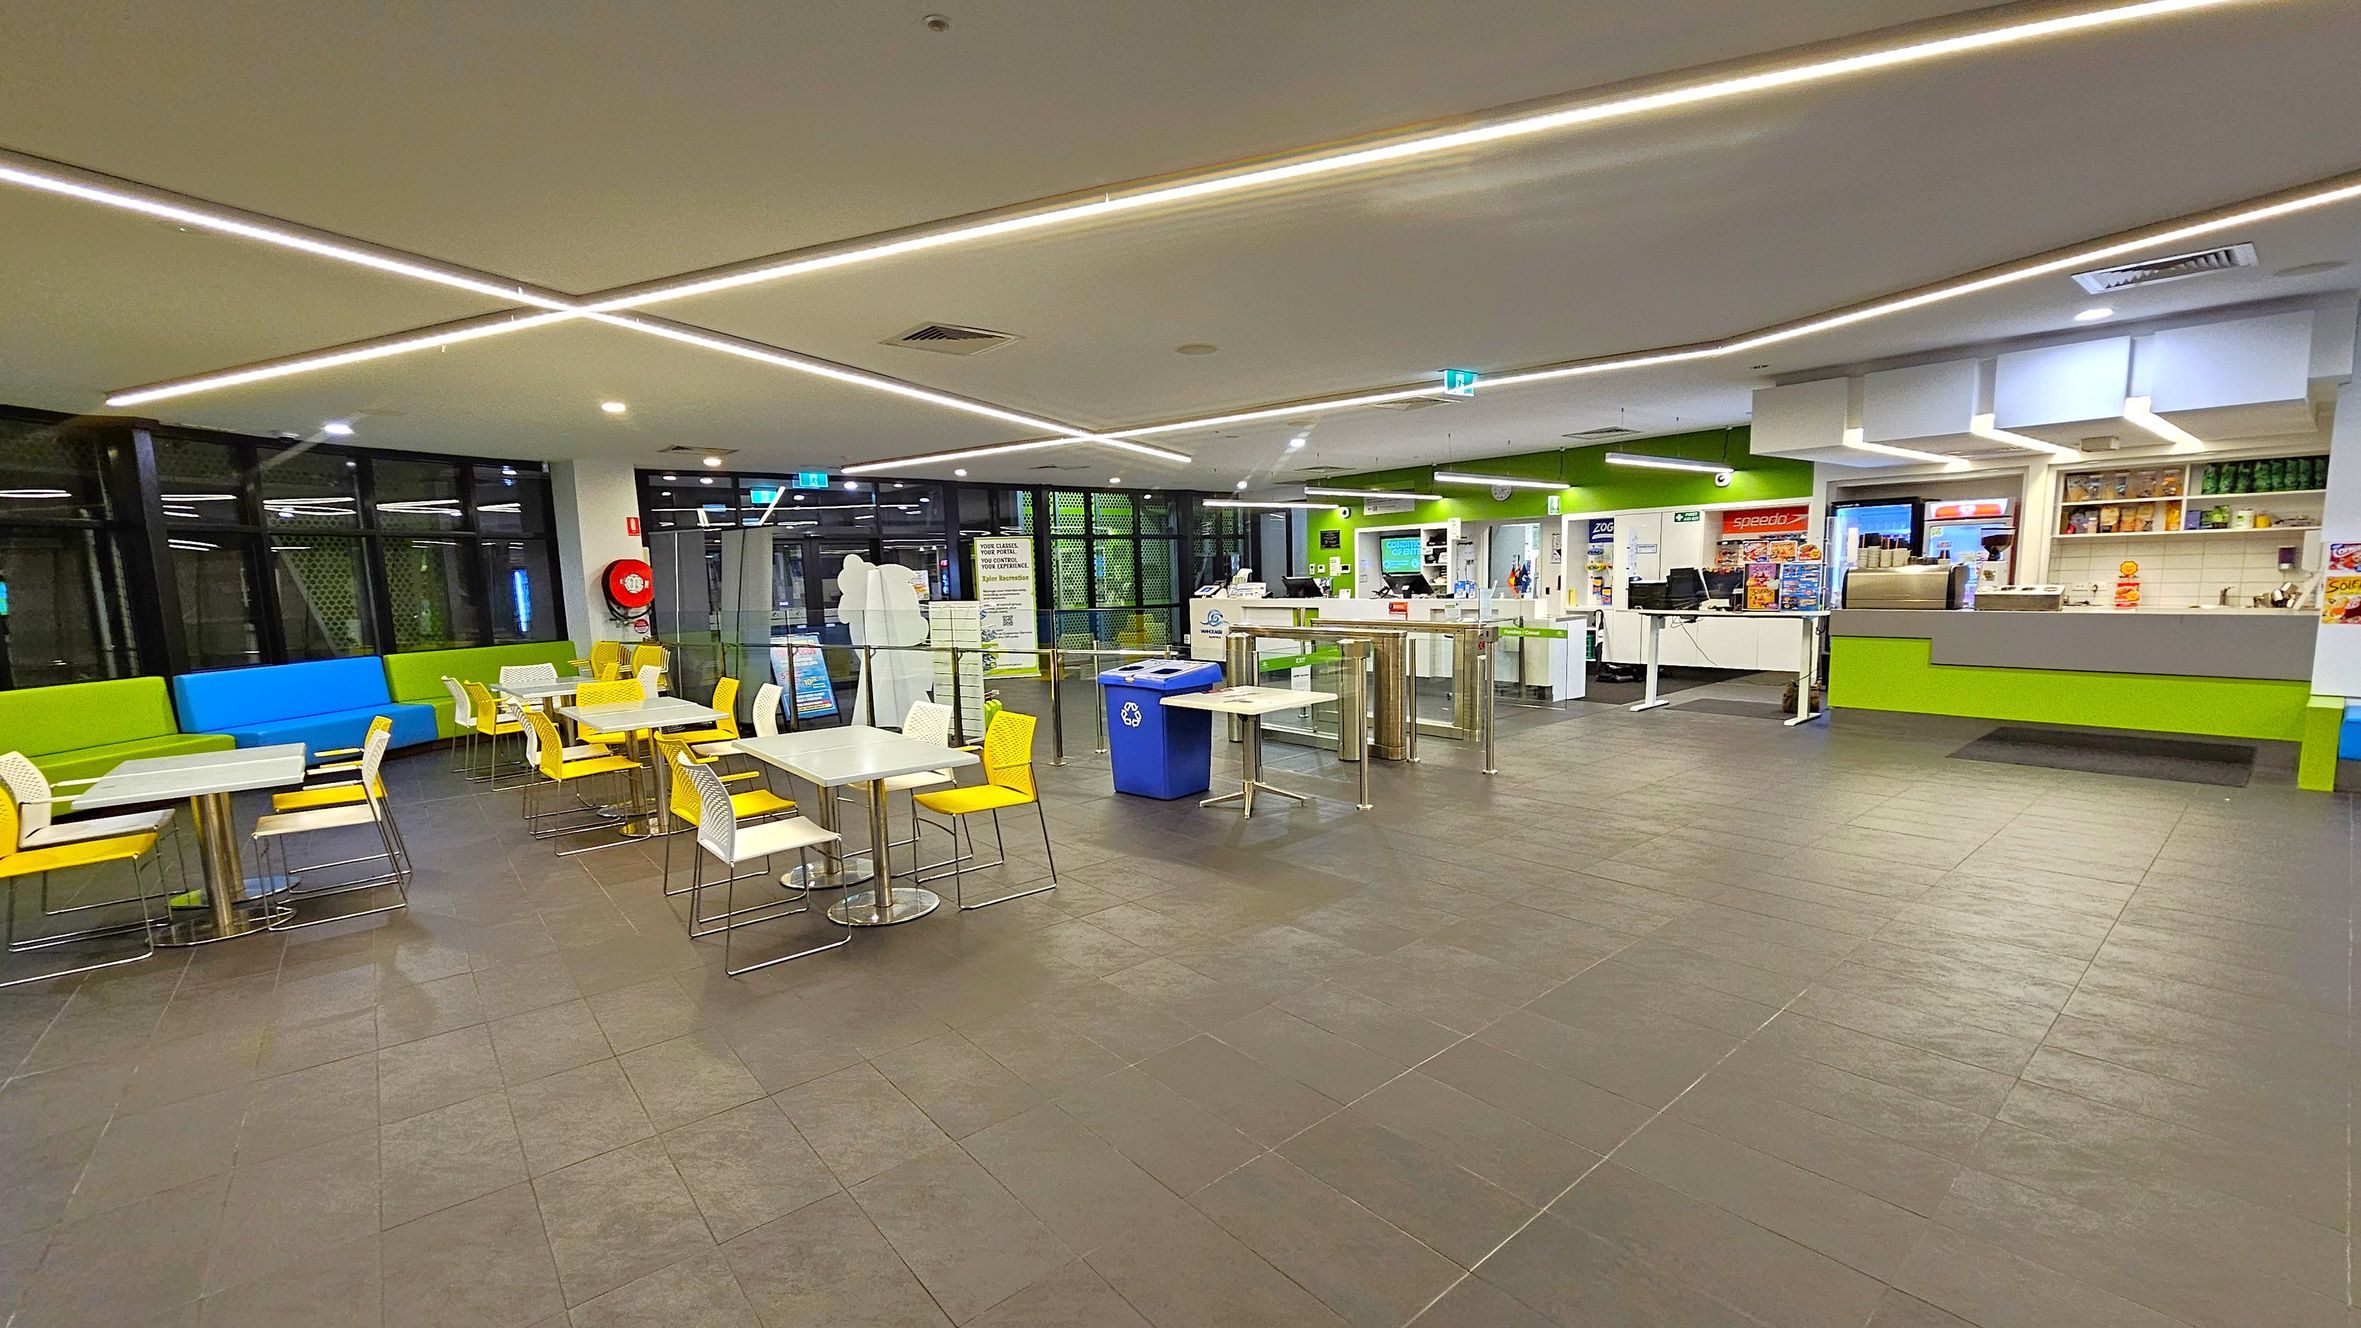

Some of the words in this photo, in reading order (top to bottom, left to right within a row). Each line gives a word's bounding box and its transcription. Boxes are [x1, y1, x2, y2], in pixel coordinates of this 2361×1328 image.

[1733, 513, 1788, 529] speedo
[1391, 548, 1402, 556] OF
[2325, 579, 2361, 593] SOLE
